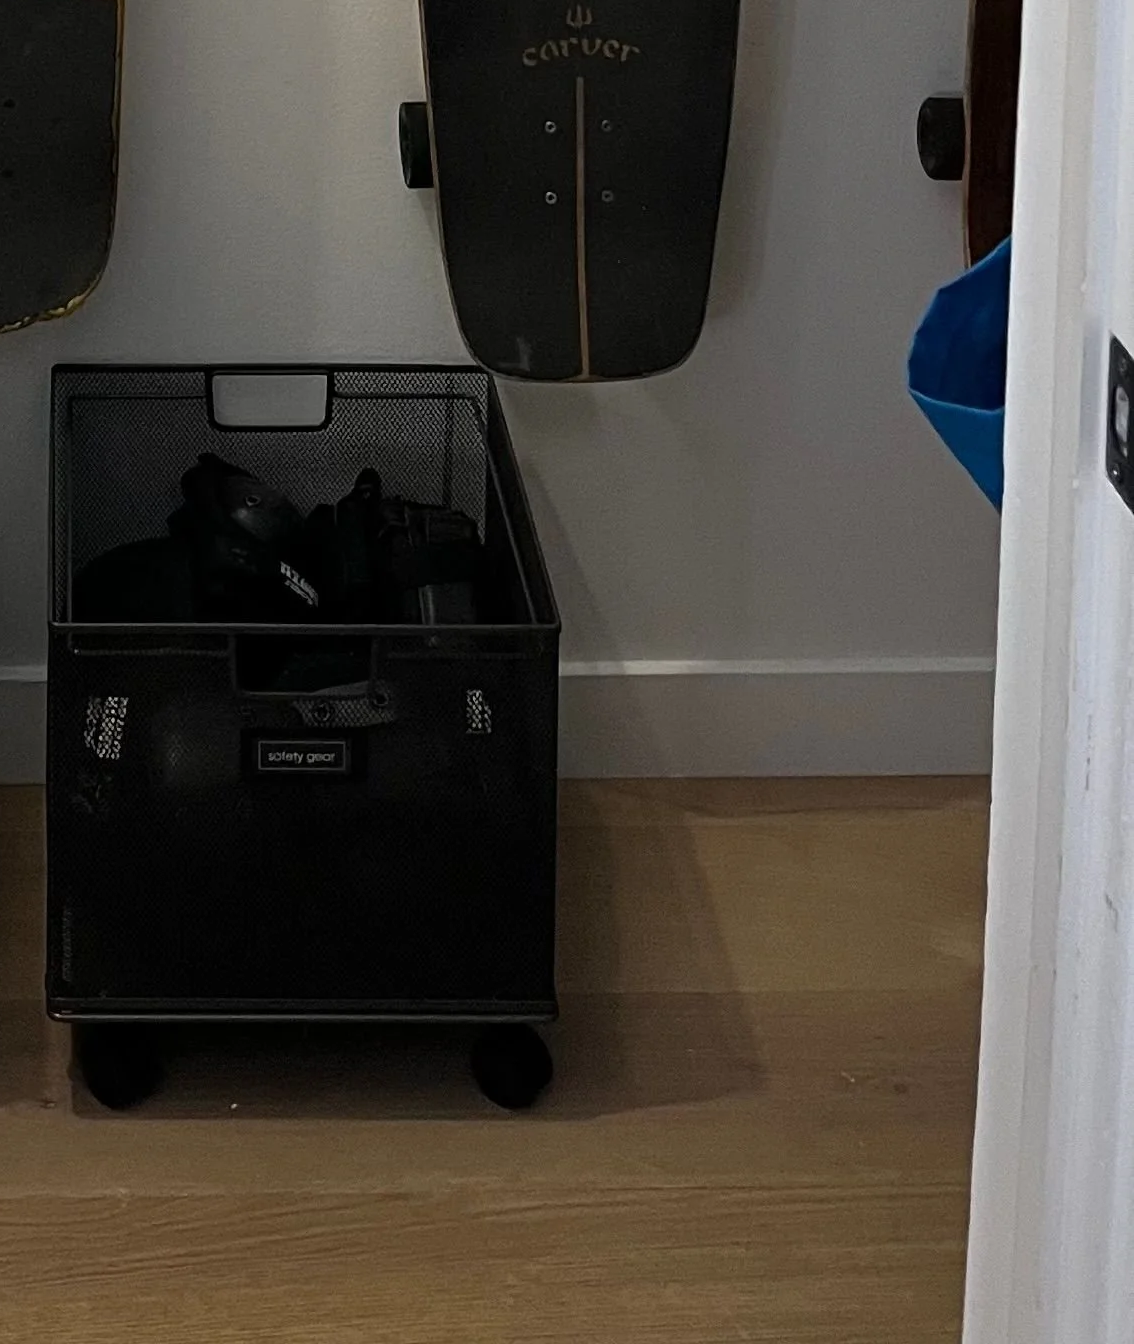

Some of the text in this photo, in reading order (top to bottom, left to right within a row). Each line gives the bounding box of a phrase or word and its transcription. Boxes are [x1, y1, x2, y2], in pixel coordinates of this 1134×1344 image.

[522, 36, 640, 67] carver
[268, 750, 336, 764] safety gear
